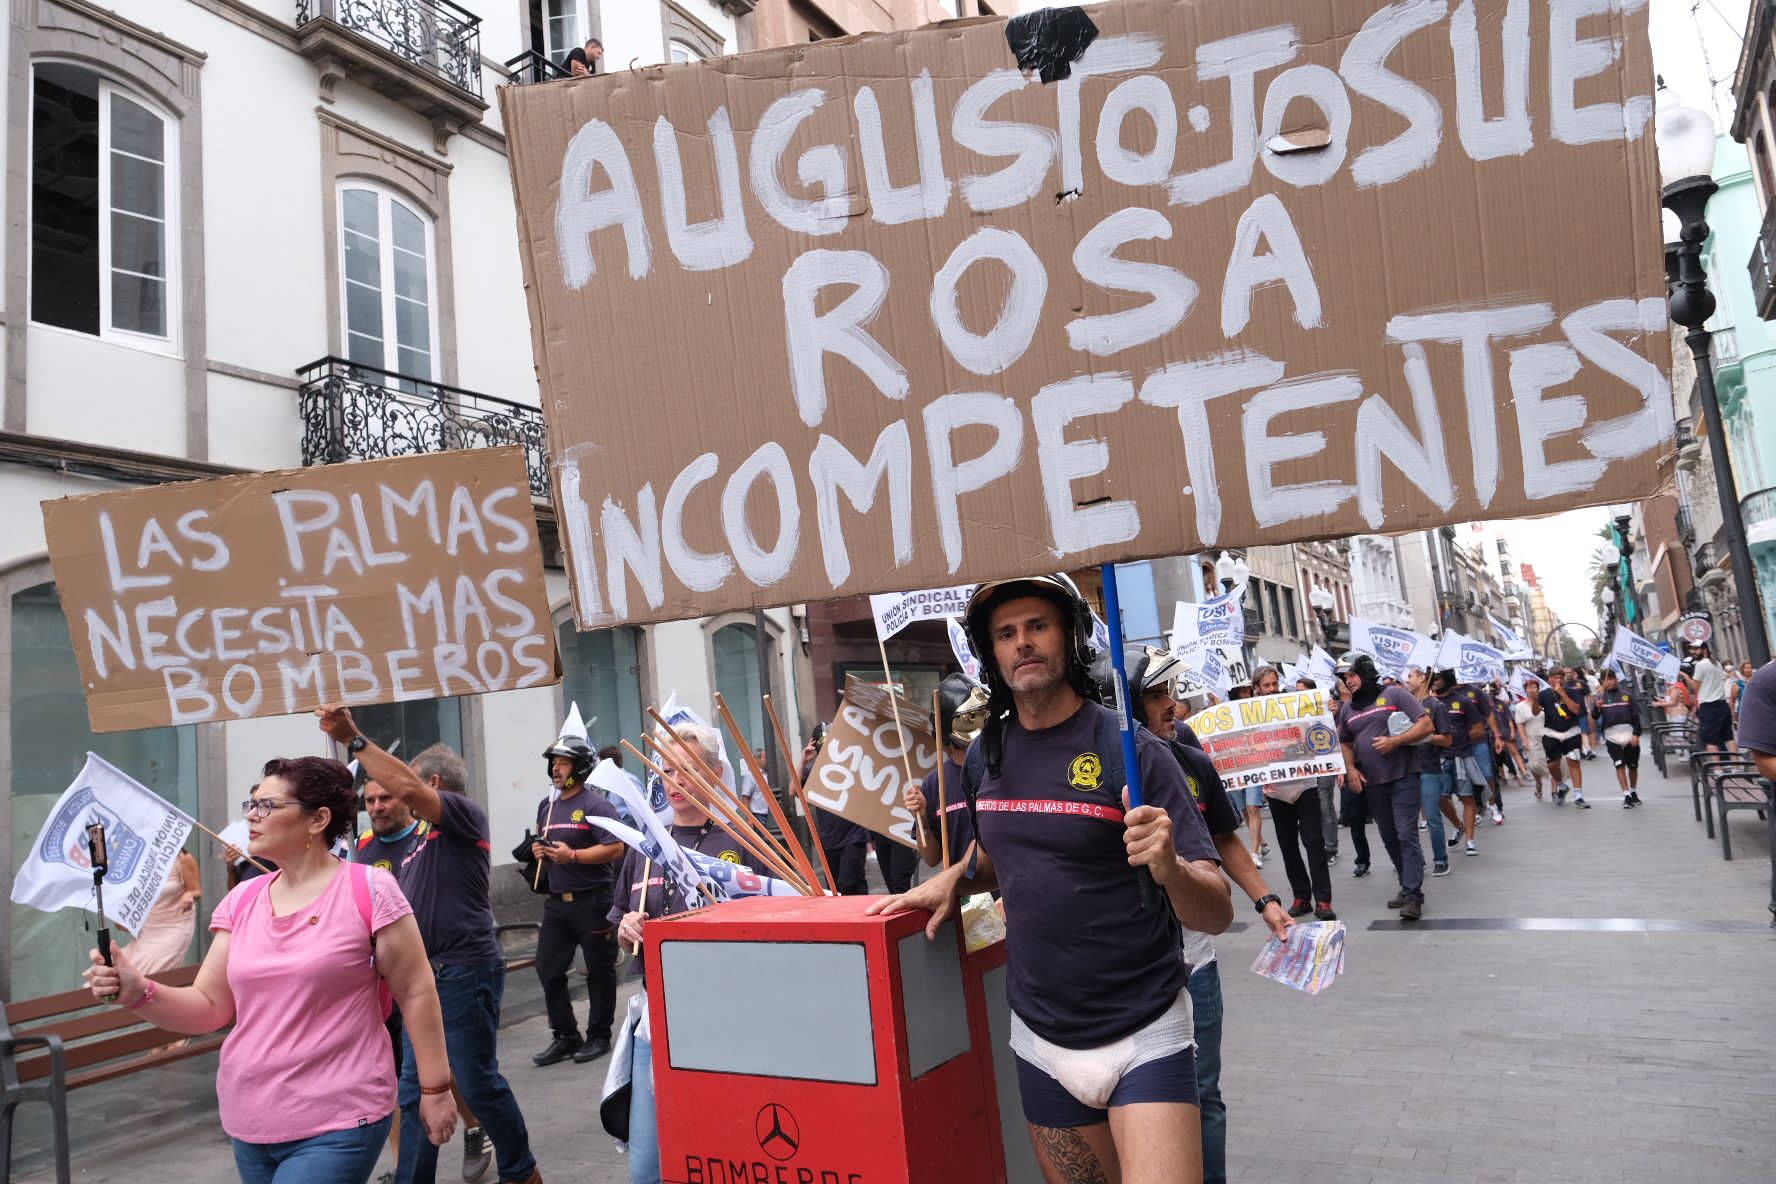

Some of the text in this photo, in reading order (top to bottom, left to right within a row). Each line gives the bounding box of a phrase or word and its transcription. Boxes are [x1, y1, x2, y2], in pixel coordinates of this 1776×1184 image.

[782, 192, 1324, 427] ROSA
[556, 293, 1674, 626] INCOMPETENTES
[99, 479, 530, 595] LAS PALMAS
[84, 568, 536, 680] NECESITA MAS
[901, 589, 962, 610] SINDICAL
[910, 607, 919, 617] Y
[922, 600, 967, 616] BOMB
[163, 634, 551, 726] BOMBEROS
[1240, 690, 1324, 728] MATA!
[807, 738, 863, 812] LOS
[1010, 801, 1027, 812] LAS
[1028, 801, 1063, 813] PALMAS
[1065, 802, 1079, 814] DE
[1237, 772, 1268, 787] LPGC
[1271, 768, 1287, 781] EN
